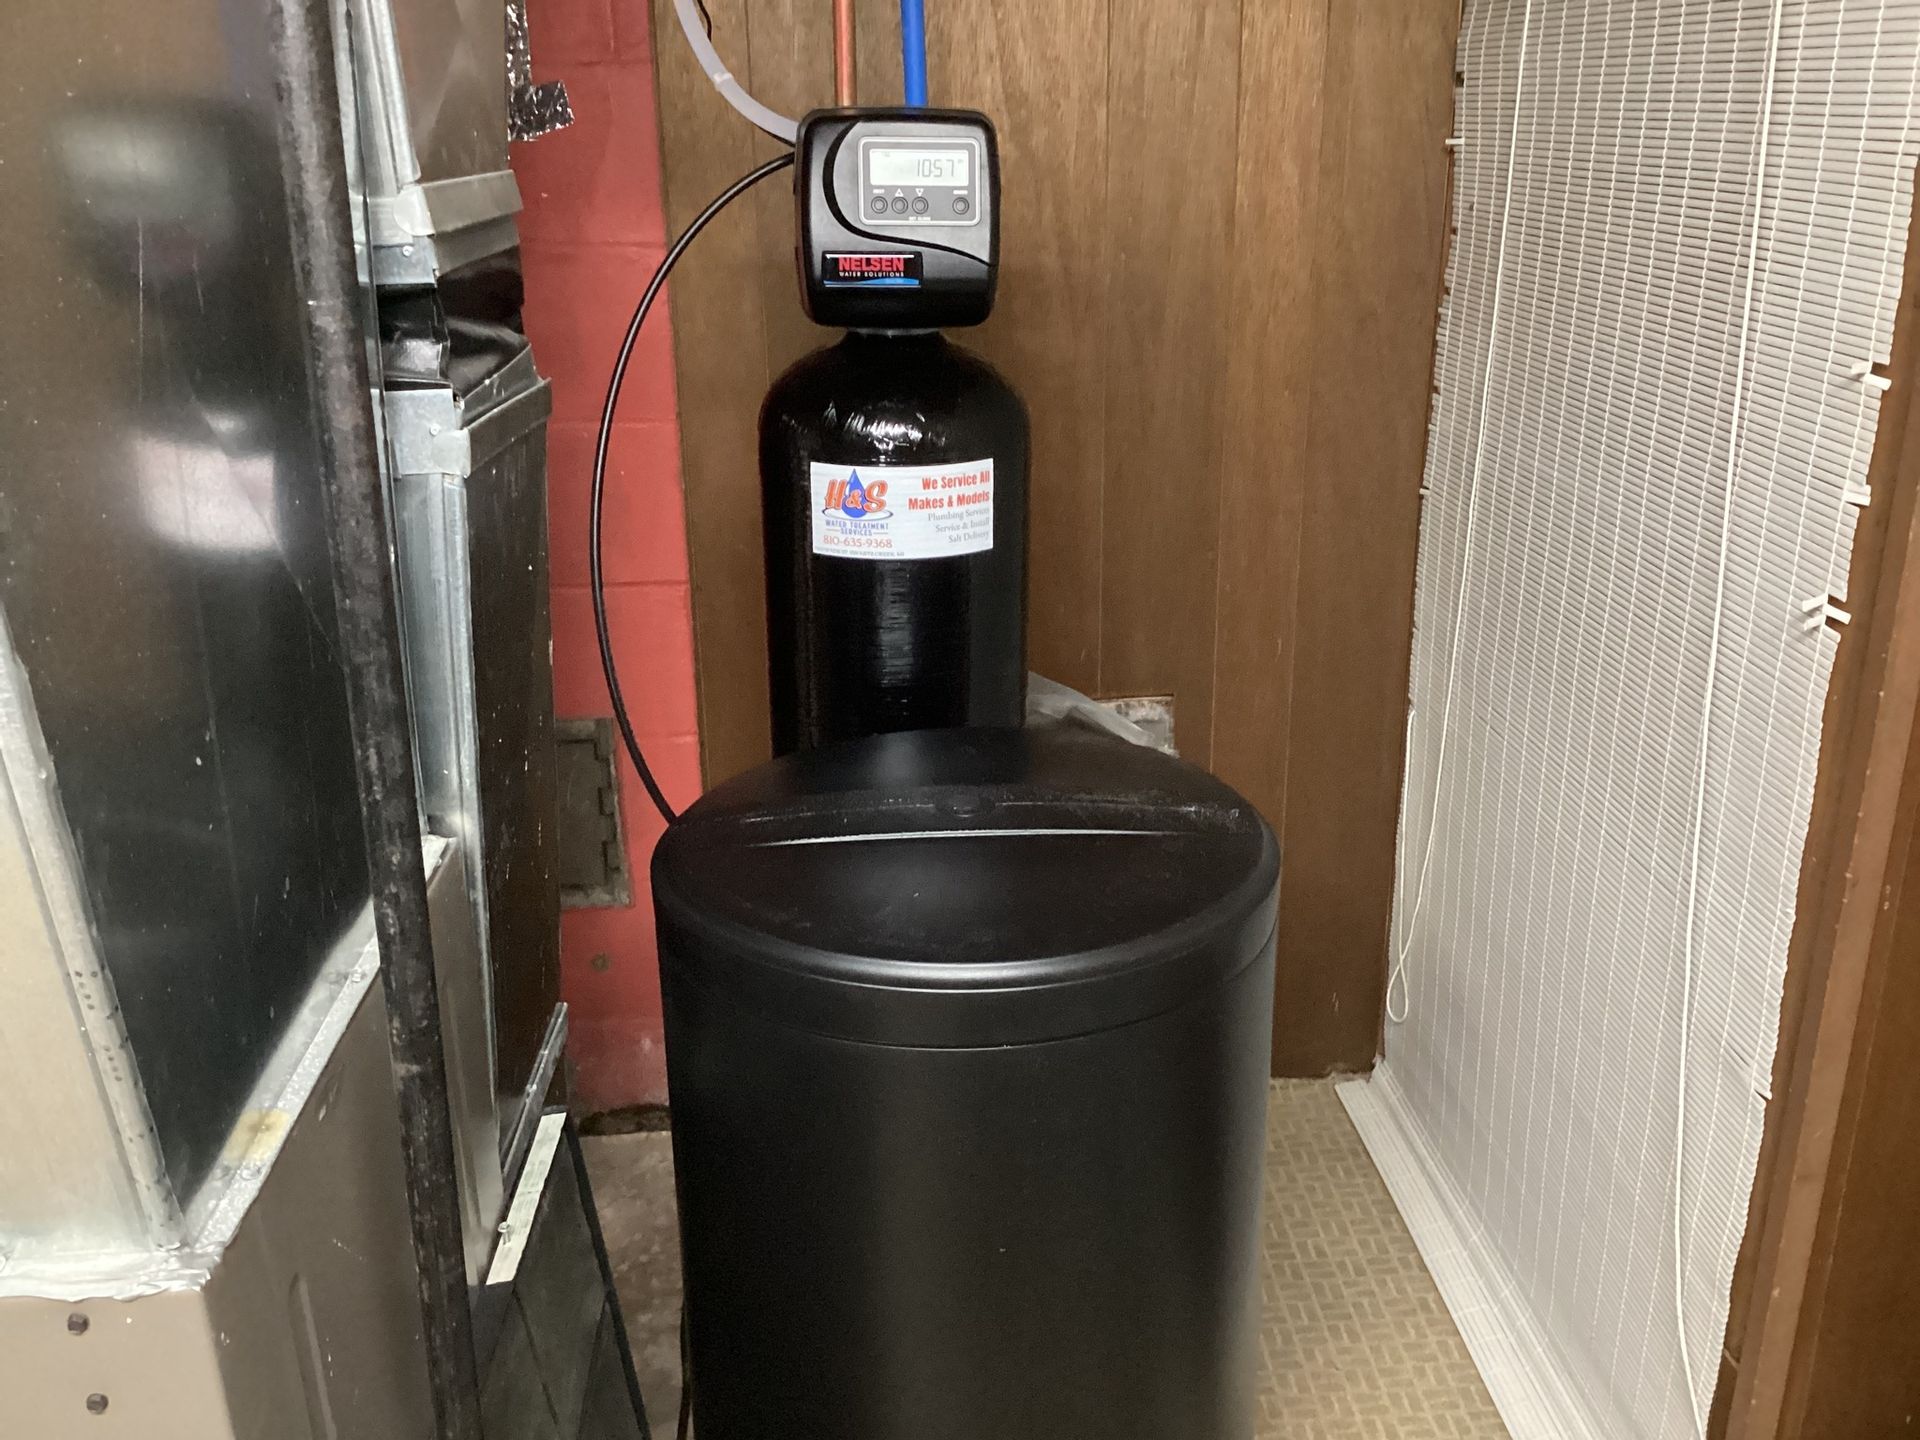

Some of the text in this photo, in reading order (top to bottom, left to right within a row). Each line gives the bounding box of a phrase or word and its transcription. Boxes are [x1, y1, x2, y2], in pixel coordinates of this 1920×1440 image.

[838, 257, 904, 271] NELSEN
[922, 470, 990, 490] We Service All
[908, 491, 990, 510] Makes & Models
[928, 511, 964, 521] Plumbing
[825, 520, 889, 530] WATER TREATMENT
[840, 528, 873, 536] SERVICES
[823, 535, 892, 548] 810-635-9368
